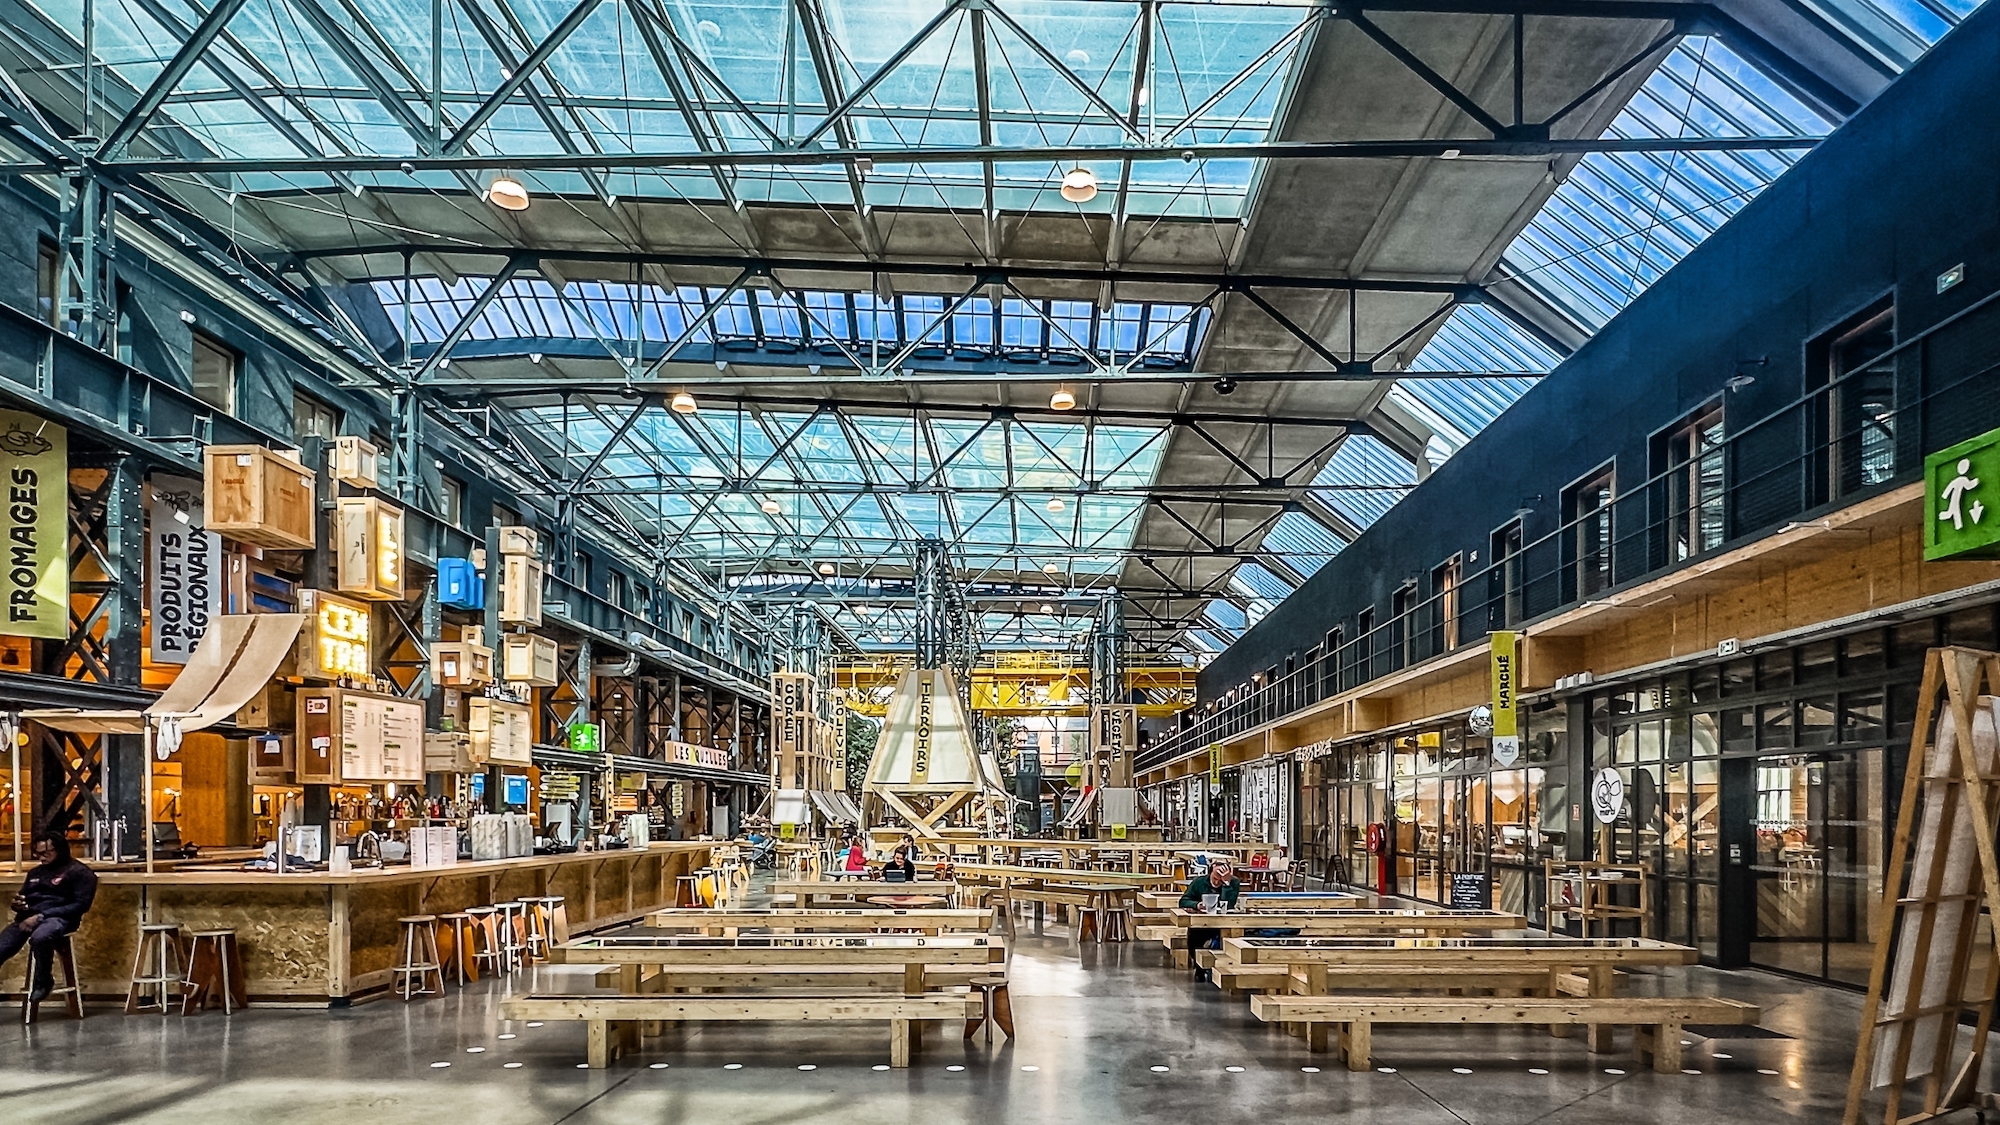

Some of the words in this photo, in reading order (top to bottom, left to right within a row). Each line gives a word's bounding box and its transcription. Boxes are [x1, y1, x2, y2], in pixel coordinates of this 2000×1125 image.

[10, 466, 39, 624] FROMAGES
[160, 532, 182, 652] PRODUITS
[1497, 655, 1510, 709] MARCHÉ
[674, 745, 689, 760] LES
[695, 749, 727, 767] QUILLES
[835, 696, 844, 769] BOLIVIE
[916, 682, 931, 772] TERROIRS
[1111, 709, 1122, 762] VÉGÉTAL
